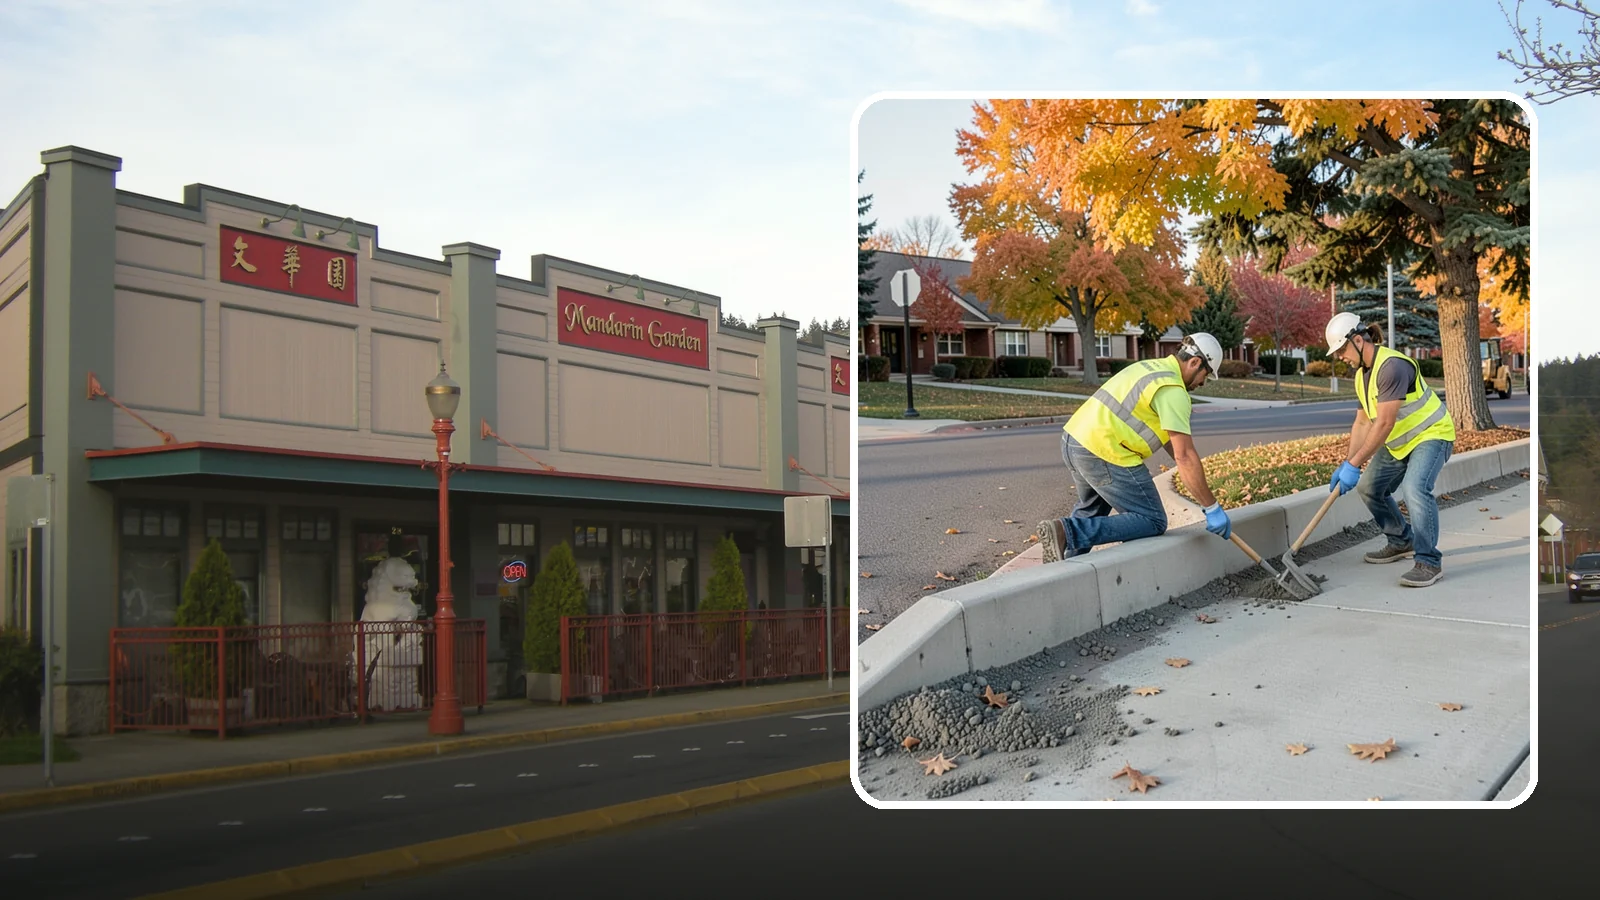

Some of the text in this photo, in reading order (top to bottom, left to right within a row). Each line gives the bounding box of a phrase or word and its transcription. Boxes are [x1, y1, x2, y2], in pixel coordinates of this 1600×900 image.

[231, 236, 346, 291] 文華園
[565, 302, 701, 352] Mandarin Garden
[503, 565, 527, 578] OPEN
